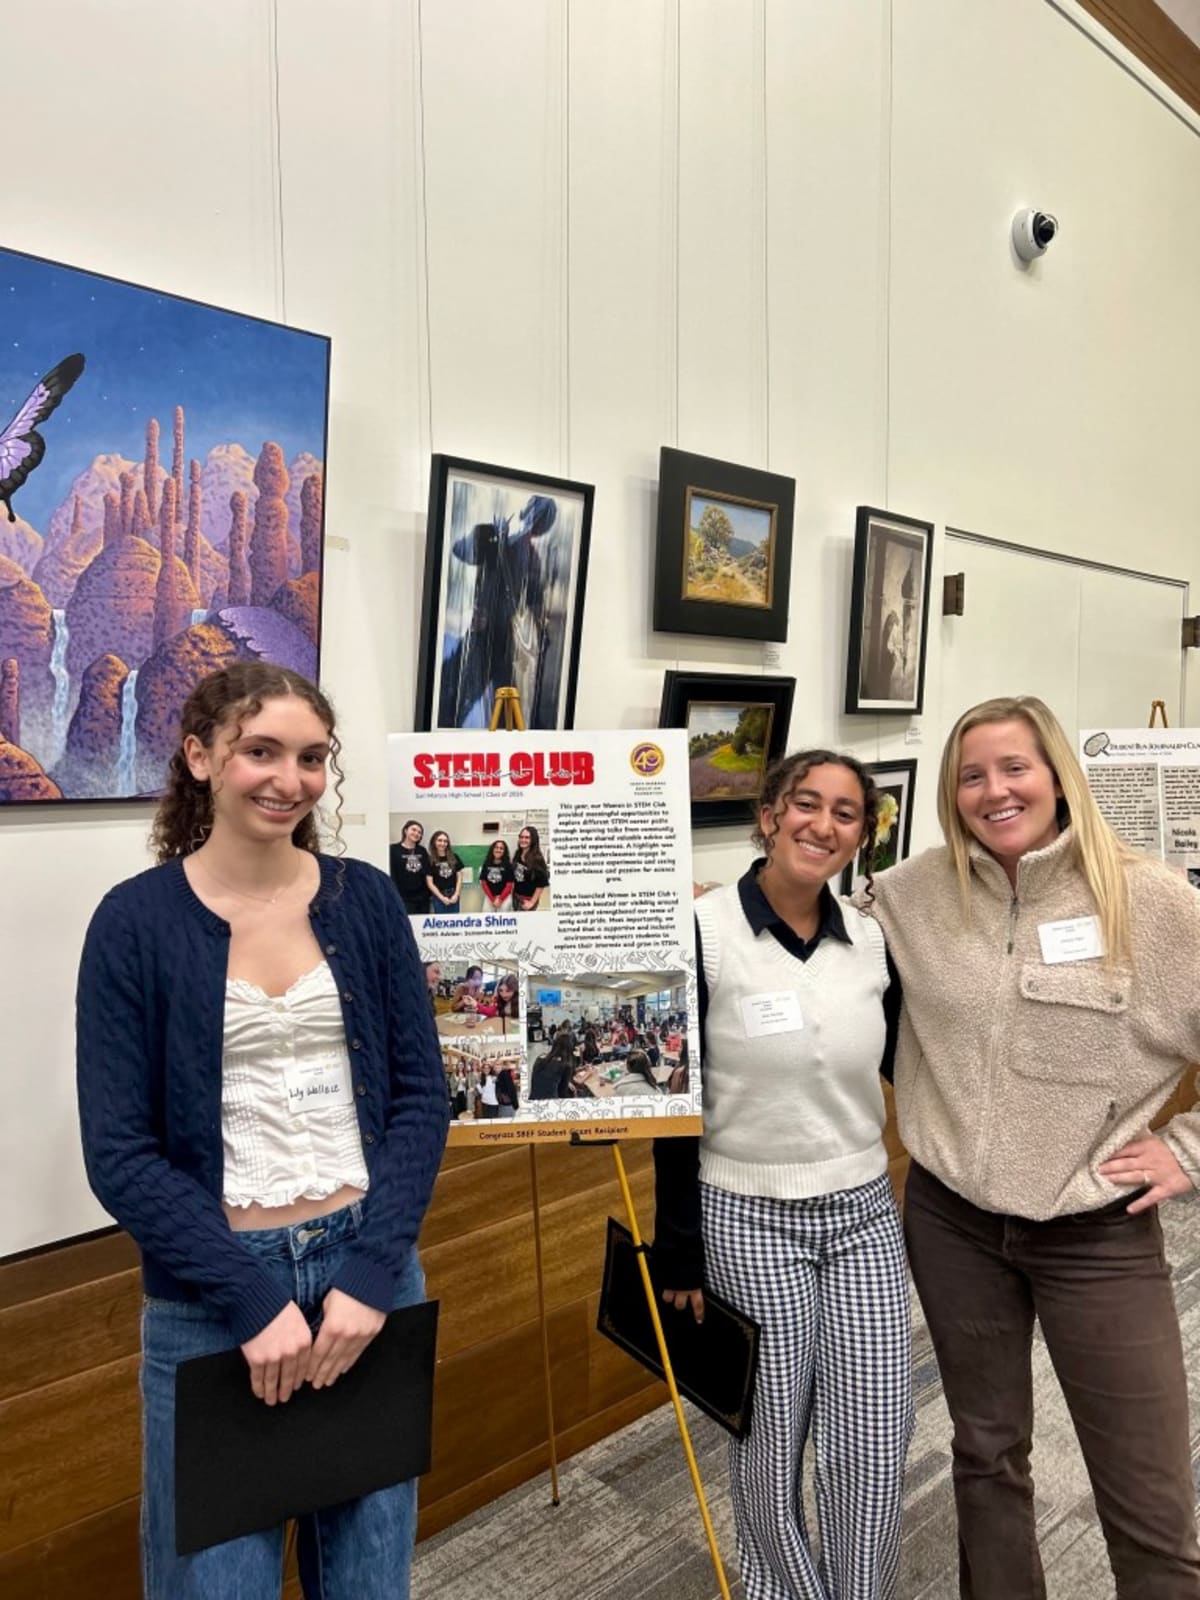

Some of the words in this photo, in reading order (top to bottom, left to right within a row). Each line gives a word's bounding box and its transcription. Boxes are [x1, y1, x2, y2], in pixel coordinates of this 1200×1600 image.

[413, 753, 500, 788] STEM
[509, 752, 594, 786] CLUB
[423, 917, 482, 928] Alexandra
[485, 915, 517, 927] Shinn
[480, 1132, 514, 1141] Congrats
[537, 1129, 566, 1137] Student
[595, 1126, 628, 1134] Recipient
